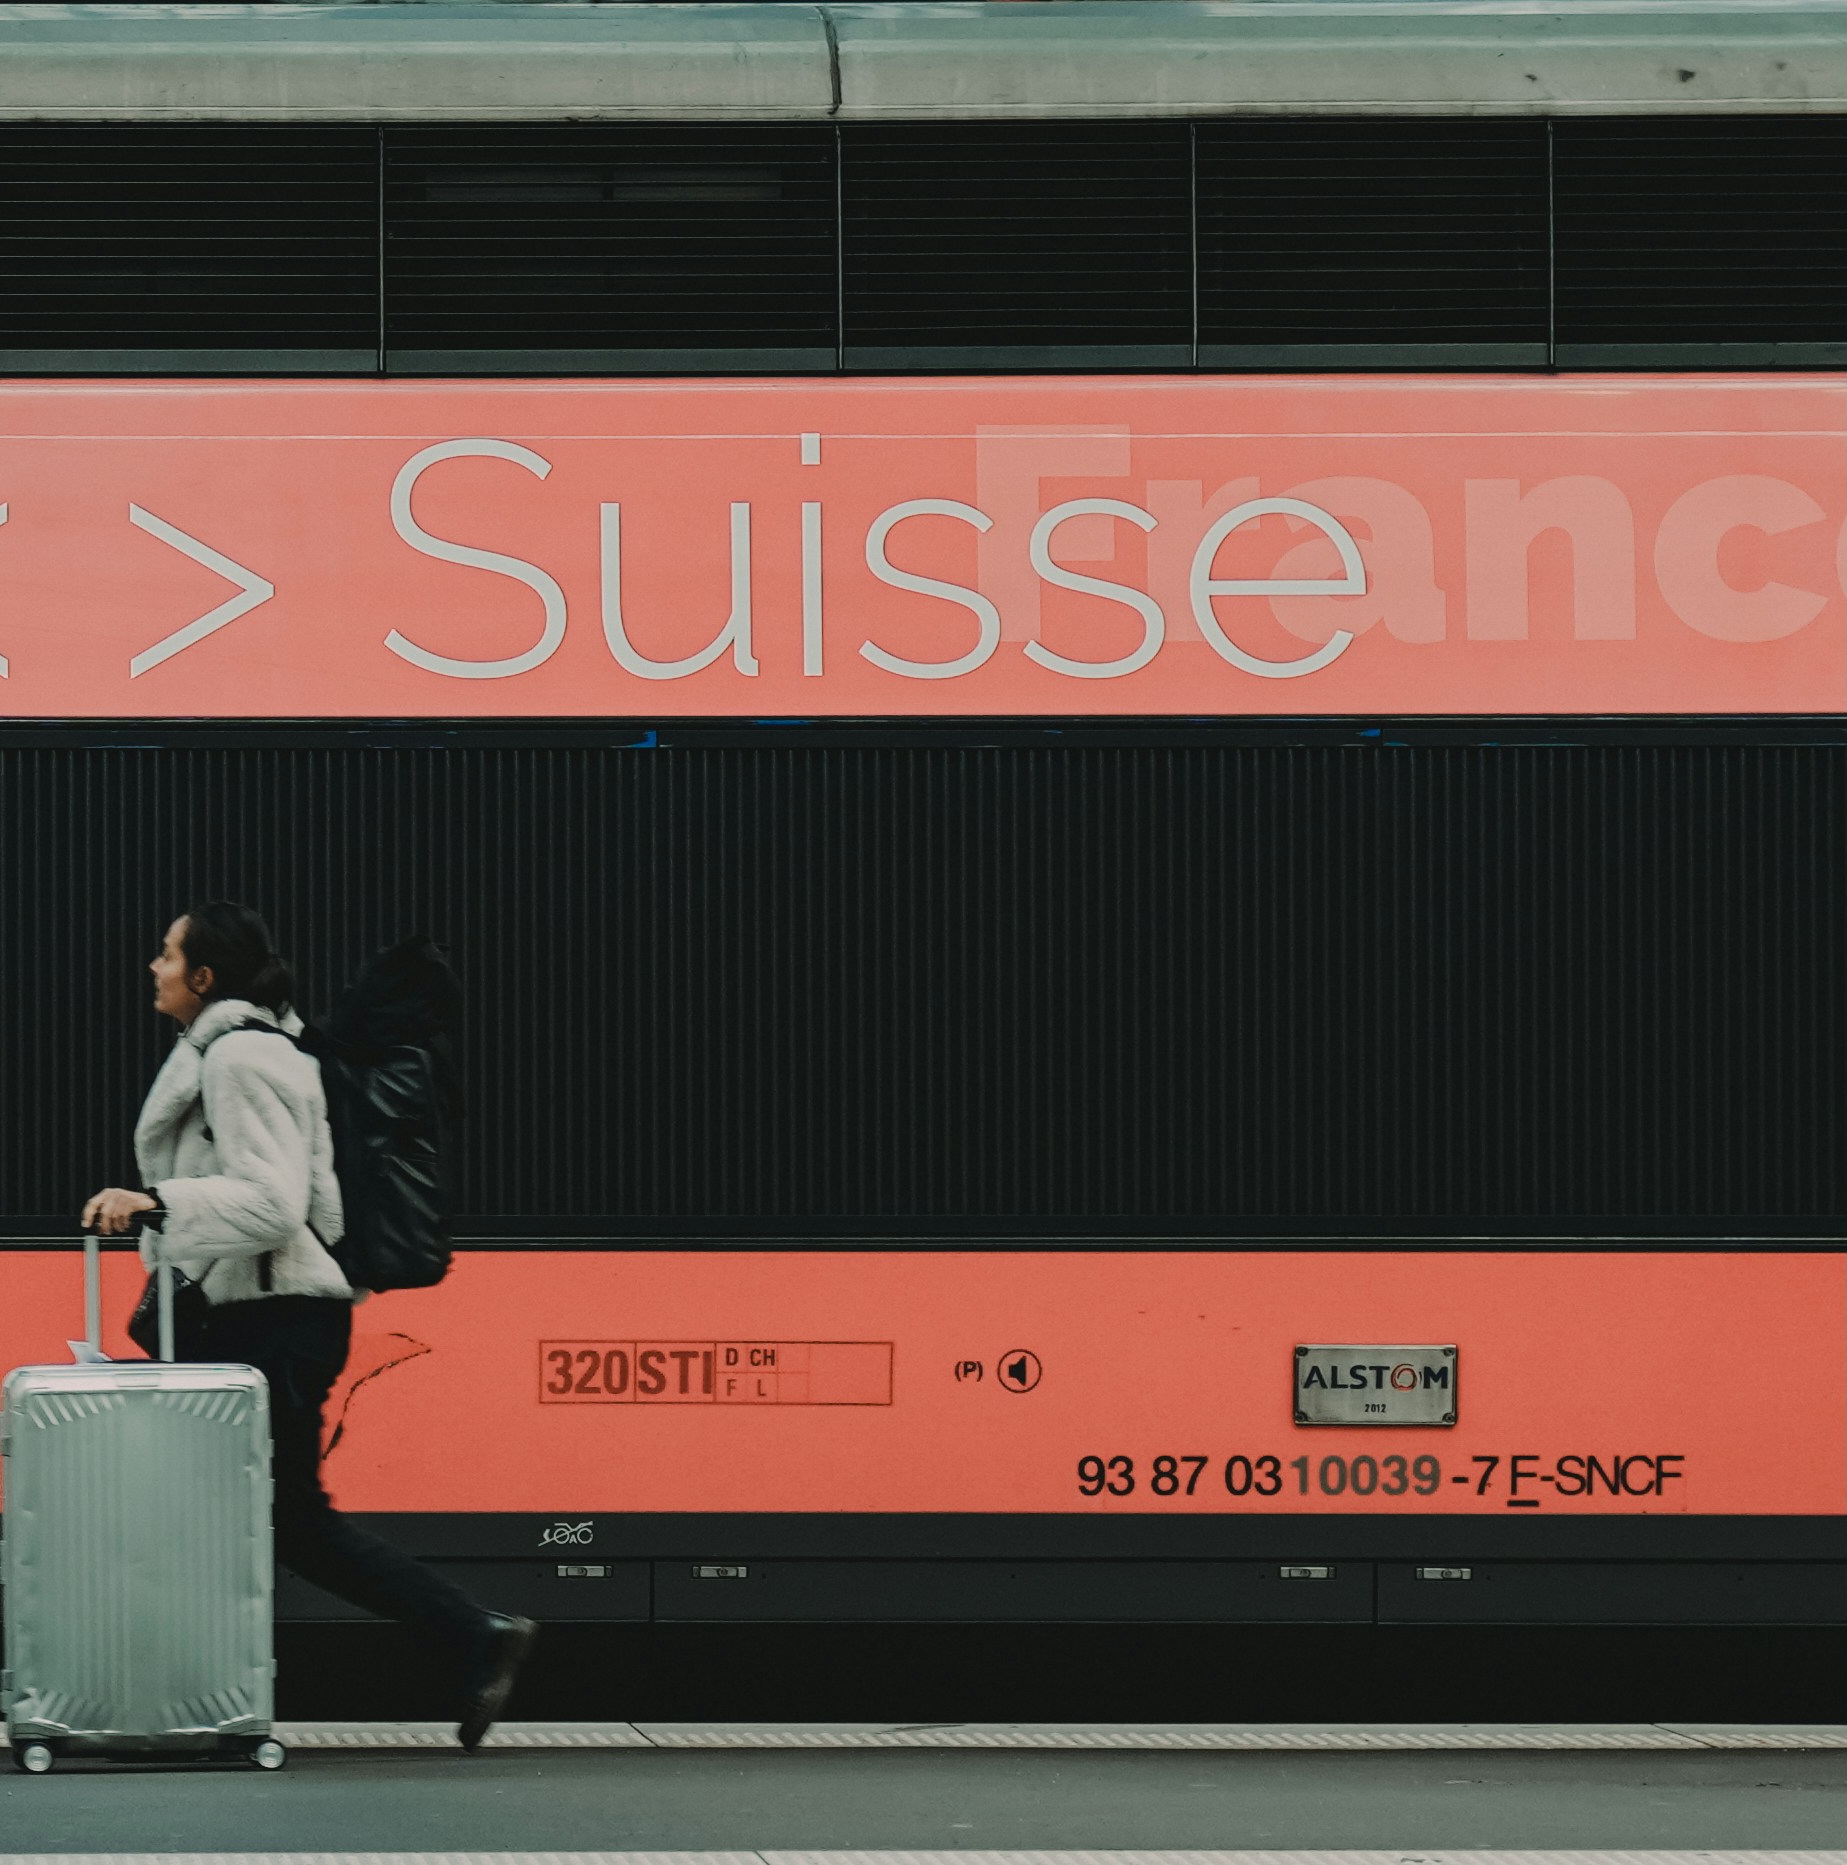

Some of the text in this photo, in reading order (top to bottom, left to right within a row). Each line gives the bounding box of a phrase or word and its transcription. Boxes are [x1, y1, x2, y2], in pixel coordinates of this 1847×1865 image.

[976, 424, 1847, 645] Franc
[383, 437, 1368, 680] Suisse
[725, 1347, 776, 1367] D CH
[954, 1360, 984, 1382] (P)
[546, 1349, 713, 1395] 320 STI
[1302, 1363, 1449, 1392] ALSTOM
[726, 1378, 768, 1397] F L
[1364, 1403, 1387, 1414] 2012
[1077, 1455, 1136, 1497] 93
[1150, 1455, 1209, 1497] 87
[1509, 1454, 1686, 1500] F-SNCF
